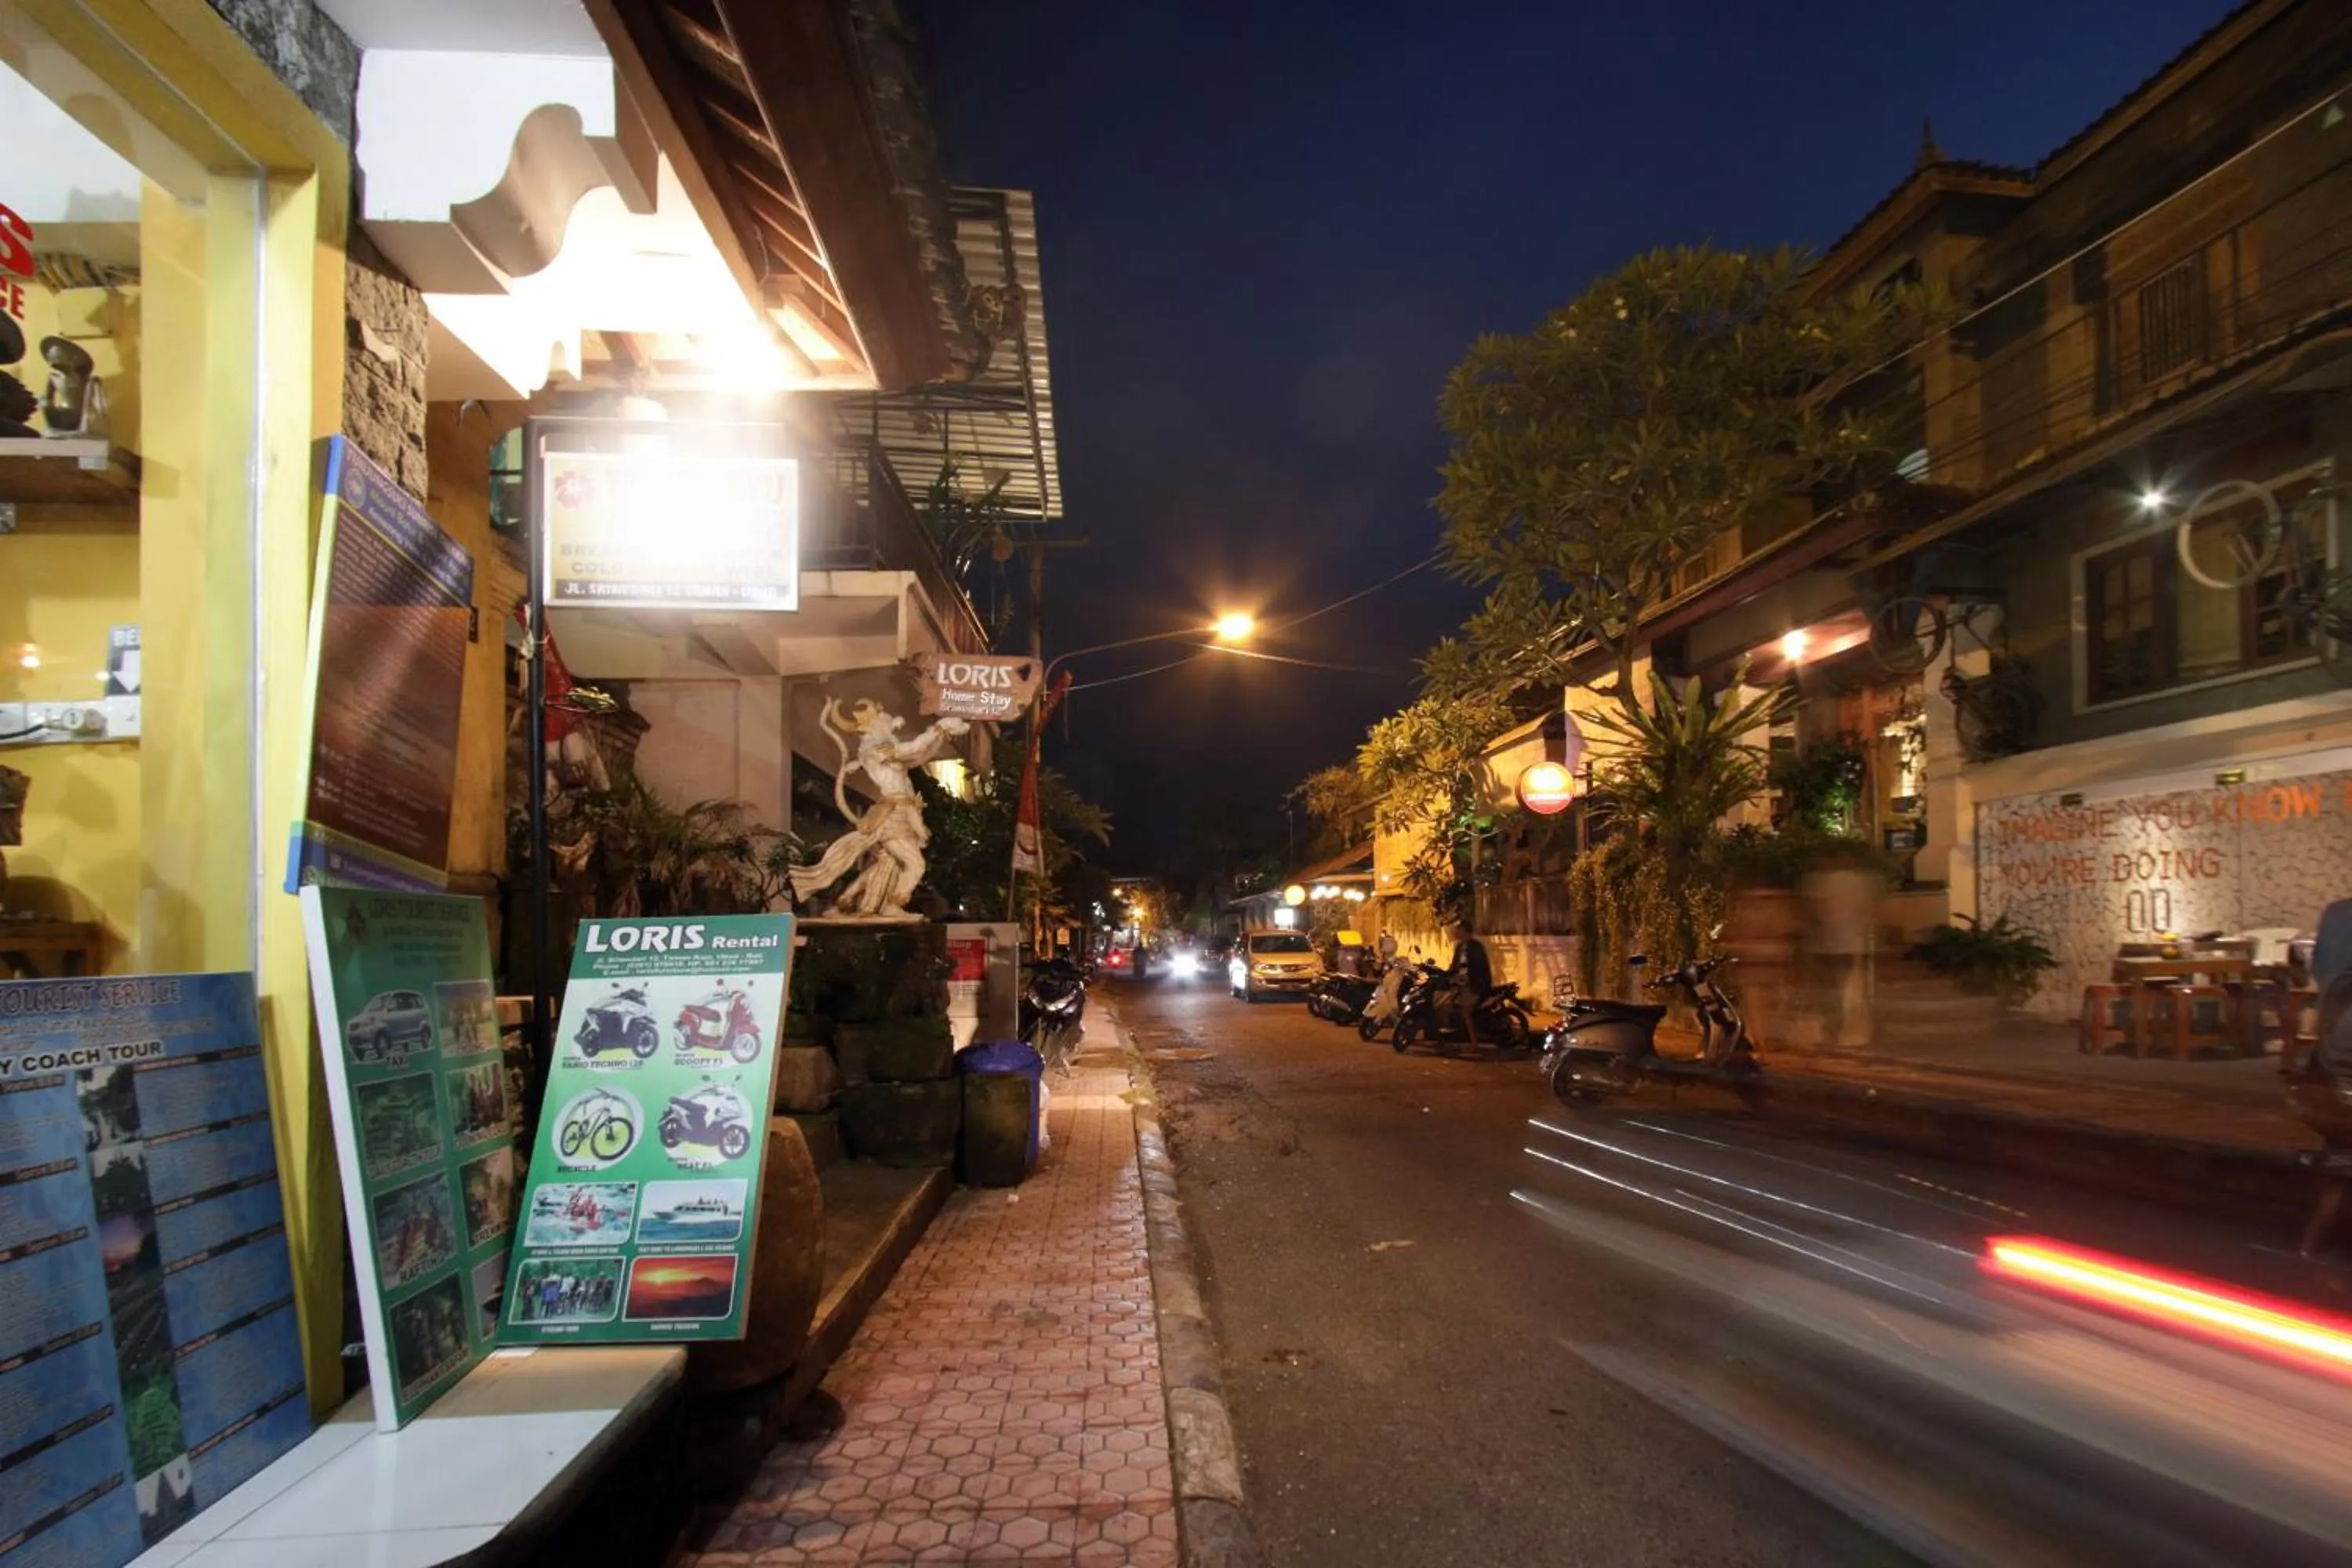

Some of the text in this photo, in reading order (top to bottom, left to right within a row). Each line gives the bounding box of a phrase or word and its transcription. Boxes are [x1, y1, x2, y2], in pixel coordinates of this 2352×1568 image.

[938, 662, 1013, 688] LORIS
[980, 691, 1011, 710] Stay
[2136, 798, 2198, 836] YOU
[2001, 856, 2097, 887] YOU'RE
[585, 924, 778, 953] LORIS Rental
[0, 985, 94, 1016] OURIST
[22, 1049, 100, 1073] COACH
[107, 1041, 163, 1062] TOUR
